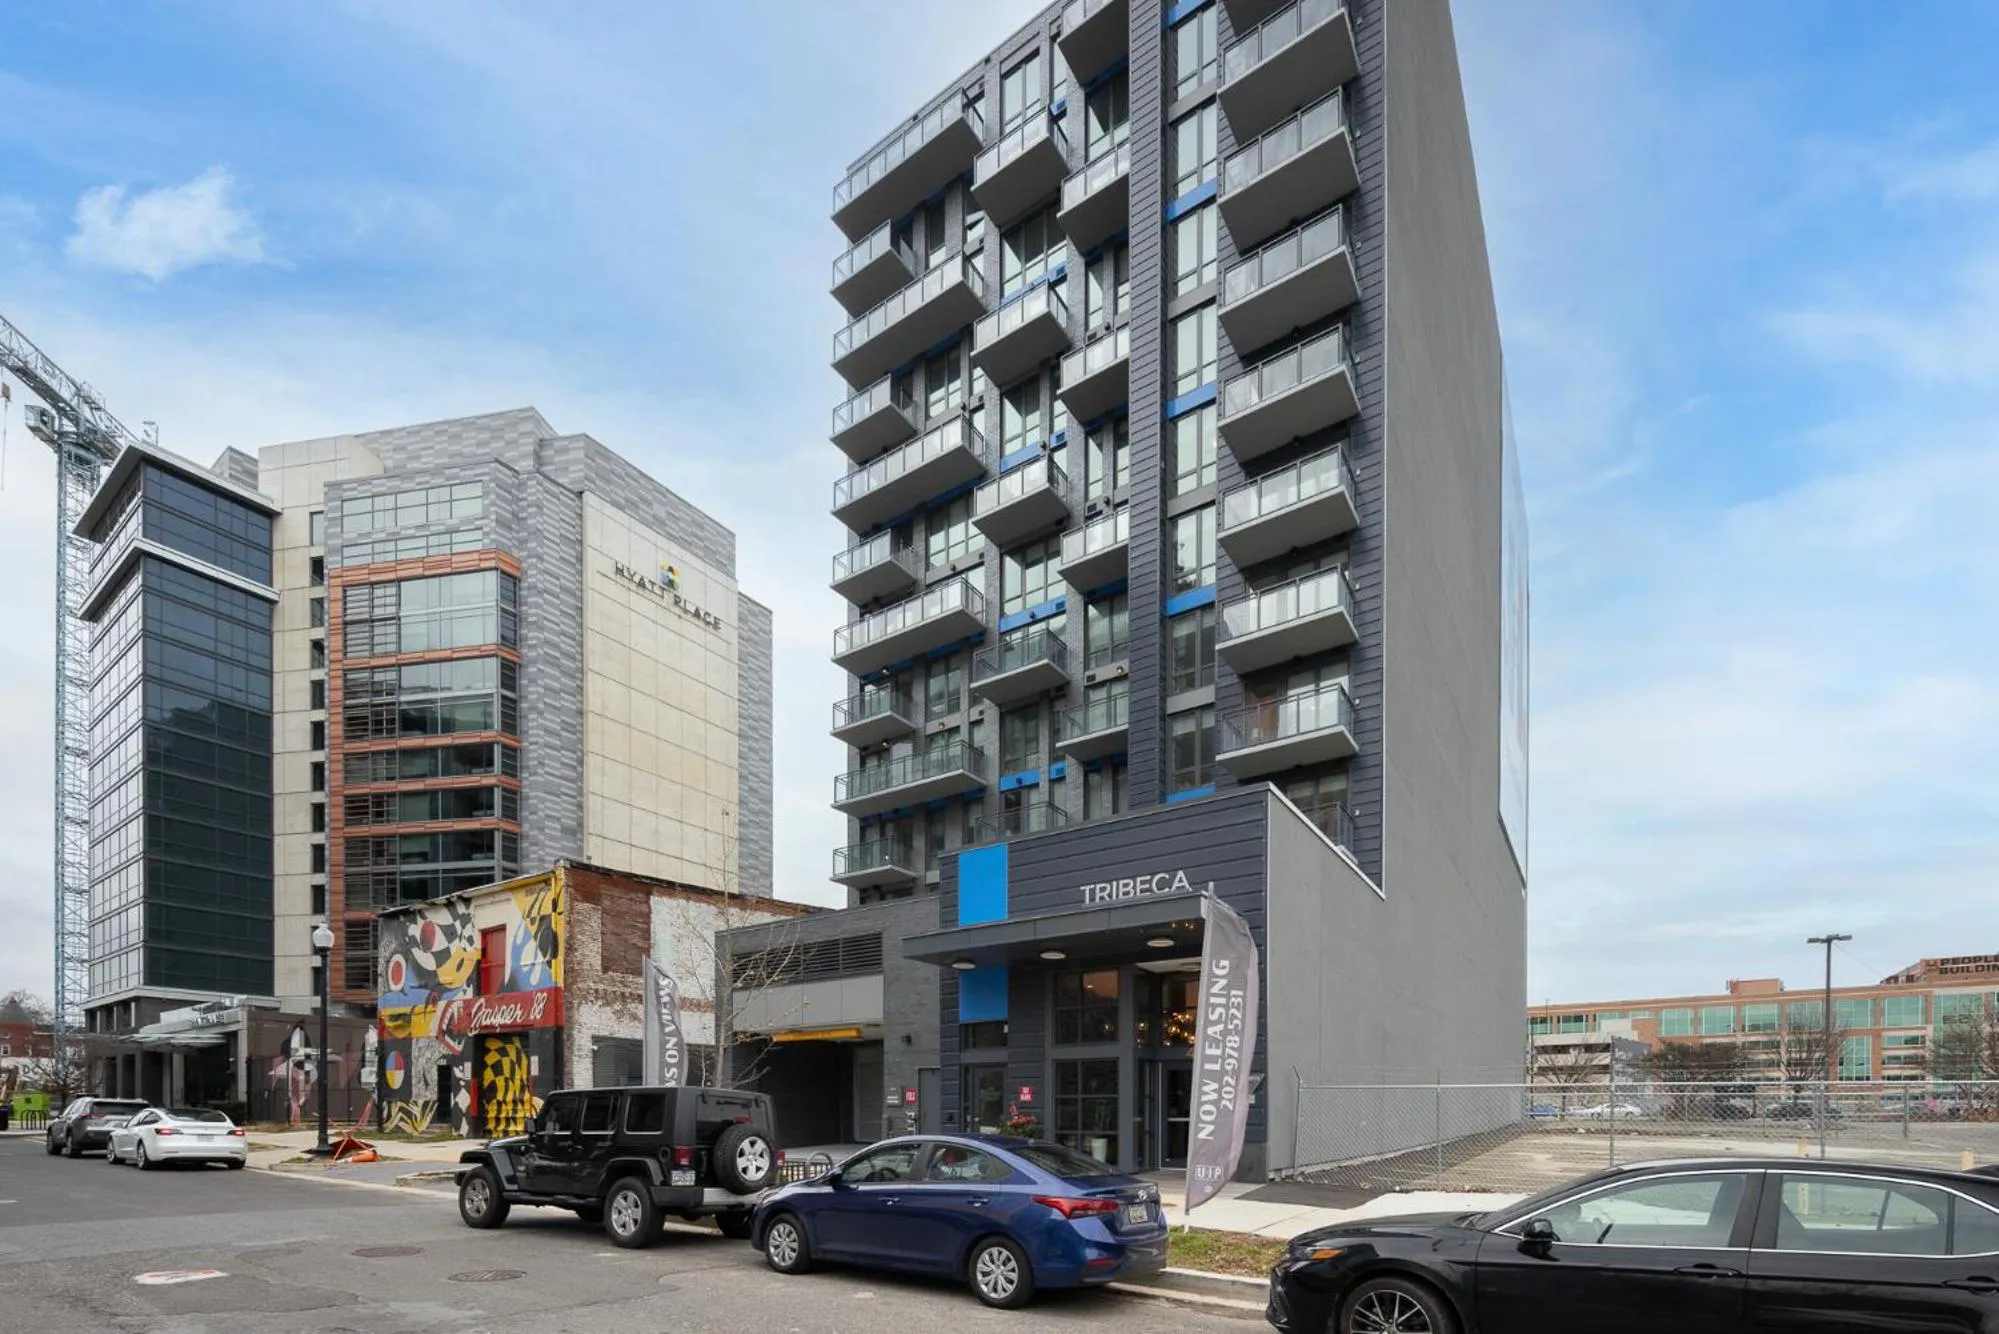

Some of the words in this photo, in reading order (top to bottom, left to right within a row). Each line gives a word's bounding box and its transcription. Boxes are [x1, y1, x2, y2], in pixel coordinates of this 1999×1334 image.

[615, 560, 665, 600] HYATT
[673, 593, 722, 631] PLACE
[1080, 869, 1193, 905] TRIBECA
[467, 997, 526, 1037] Jasper
[1204, 959, 1230, 1071] LEASING
[665, 1036, 679, 1064] ON
[1220, 989, 1244, 1111] 202-978-5231
[1197, 1078, 1220, 1140] NOW
